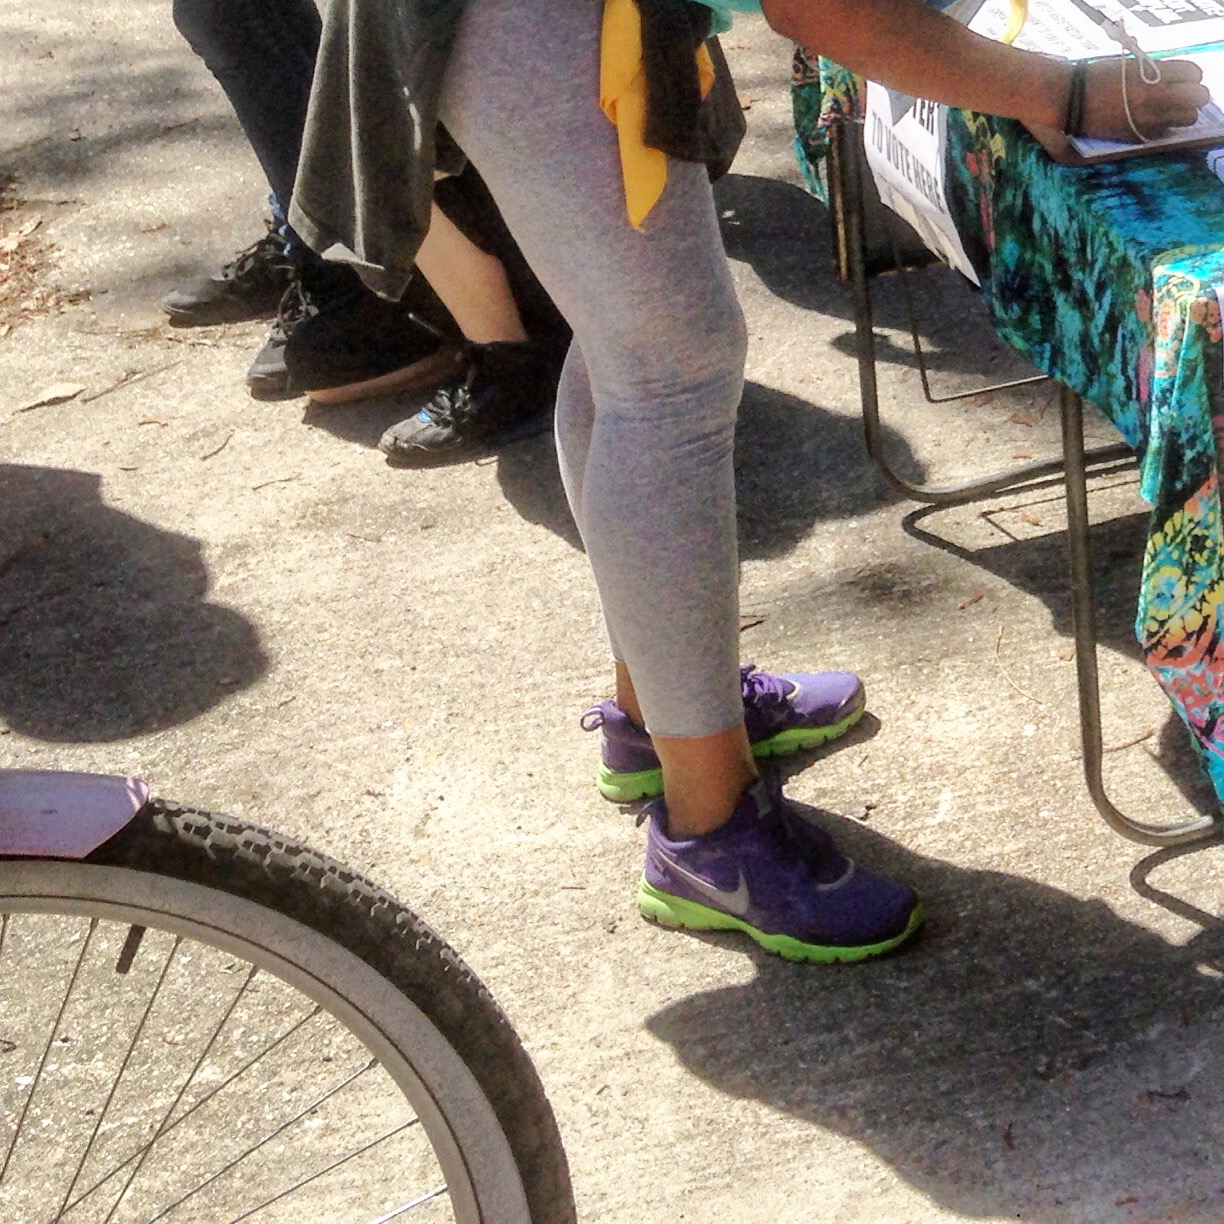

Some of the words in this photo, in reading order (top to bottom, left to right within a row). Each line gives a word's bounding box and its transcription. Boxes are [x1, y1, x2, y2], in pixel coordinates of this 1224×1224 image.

[872, 109, 883, 153] TO
[884, 124, 913, 184] VOTE
[912, 155, 945, 215] HERE
